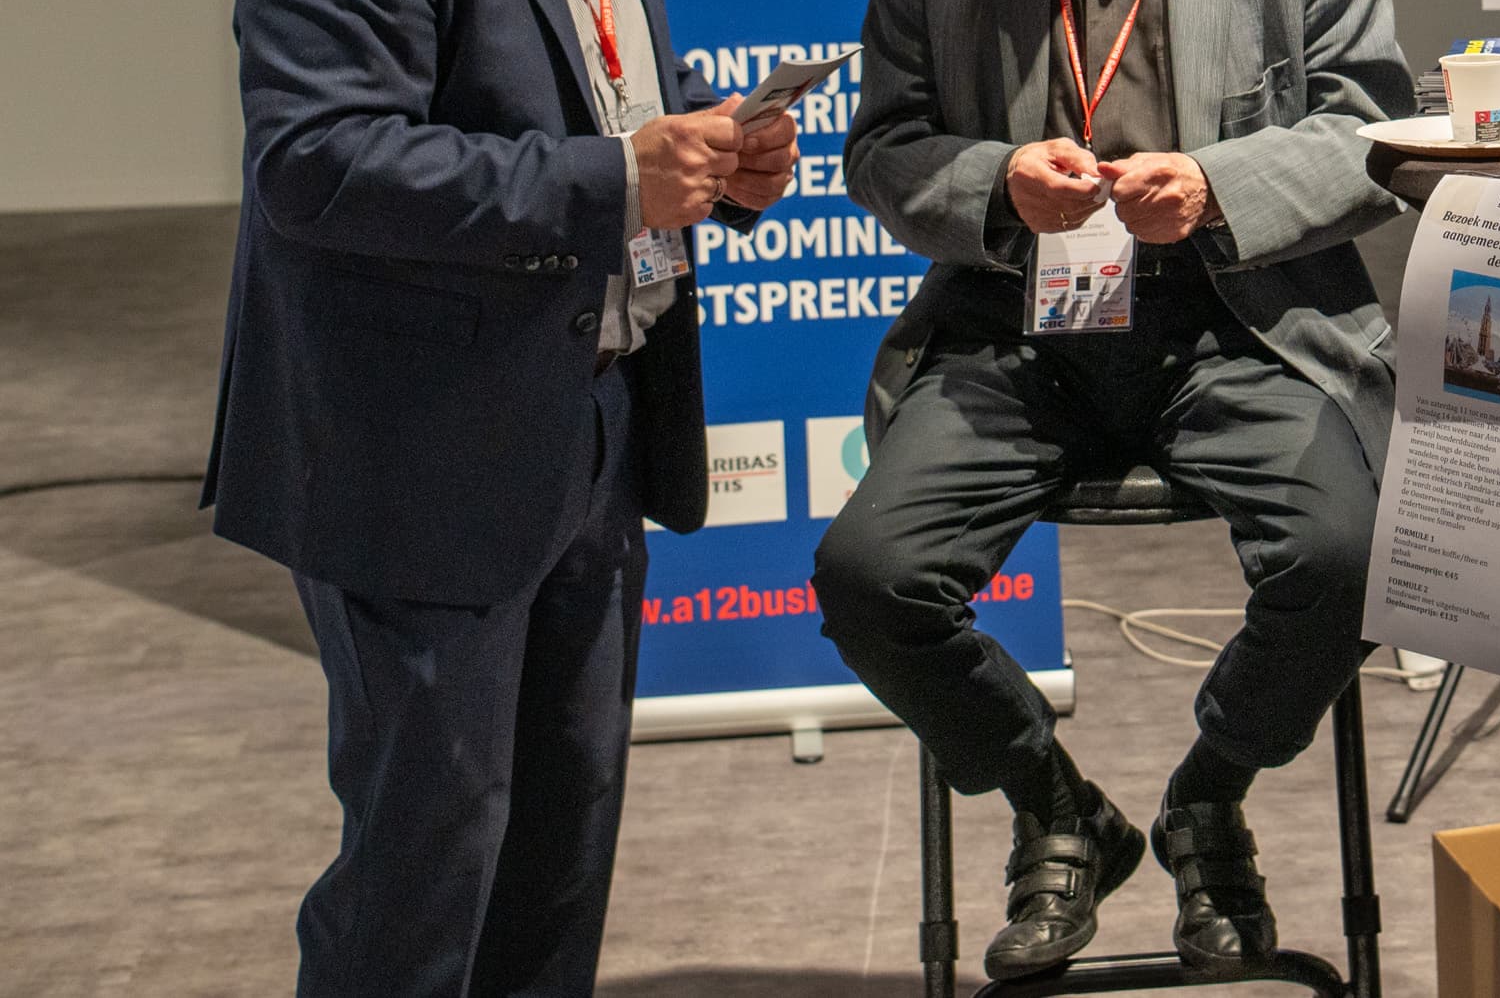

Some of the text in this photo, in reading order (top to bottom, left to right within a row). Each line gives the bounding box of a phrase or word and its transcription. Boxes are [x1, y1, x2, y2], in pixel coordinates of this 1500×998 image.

[1442, 210, 1481, 227] Bezoek
[1040, 266, 1071, 277] acerta
[1436, 442, 1453, 454] langs
[1454, 446, 1462, 455] de
[1463, 449, 1490, 462] schepen
[709, 453, 778, 473] RIBAS
[712, 480, 743, 493] TIS
[1395, 526, 1429, 540] FORMULE
[1388, 576, 1422, 592] FORMULE
